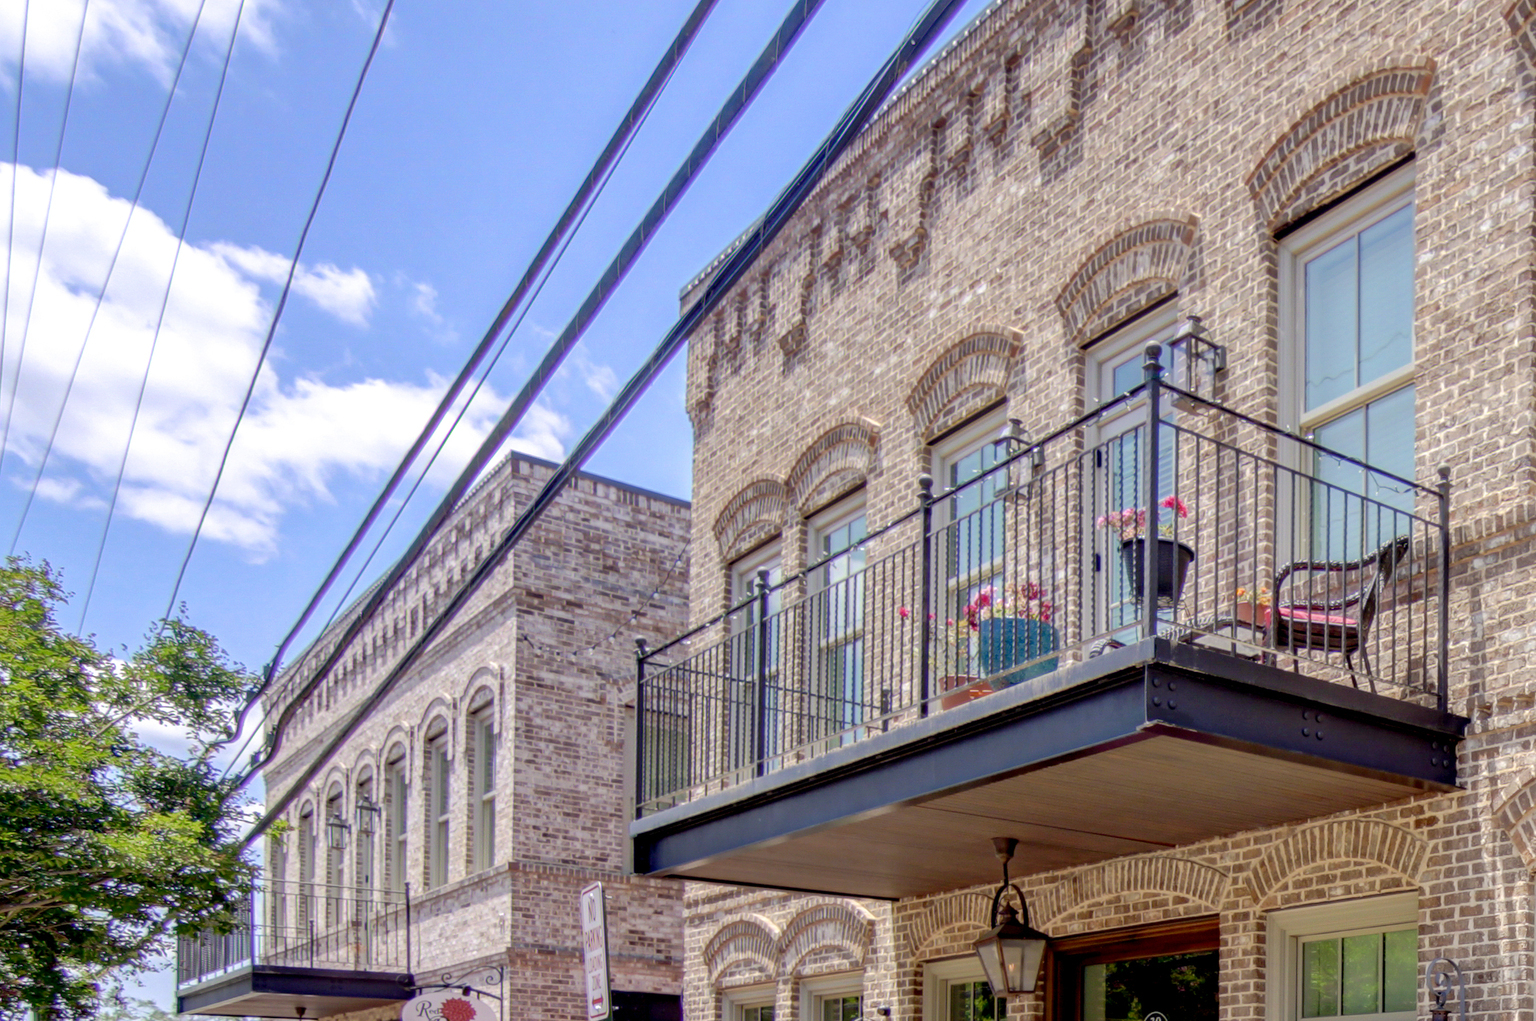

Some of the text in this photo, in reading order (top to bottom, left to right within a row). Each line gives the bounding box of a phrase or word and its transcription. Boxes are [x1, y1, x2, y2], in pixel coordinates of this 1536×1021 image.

[588, 899, 597, 923] NO
[585, 925, 603, 949] PARKING
[587, 953, 603, 974] LOADING
[591, 973, 602, 991] ZONE
[415, 1000, 441, 1020] Red
